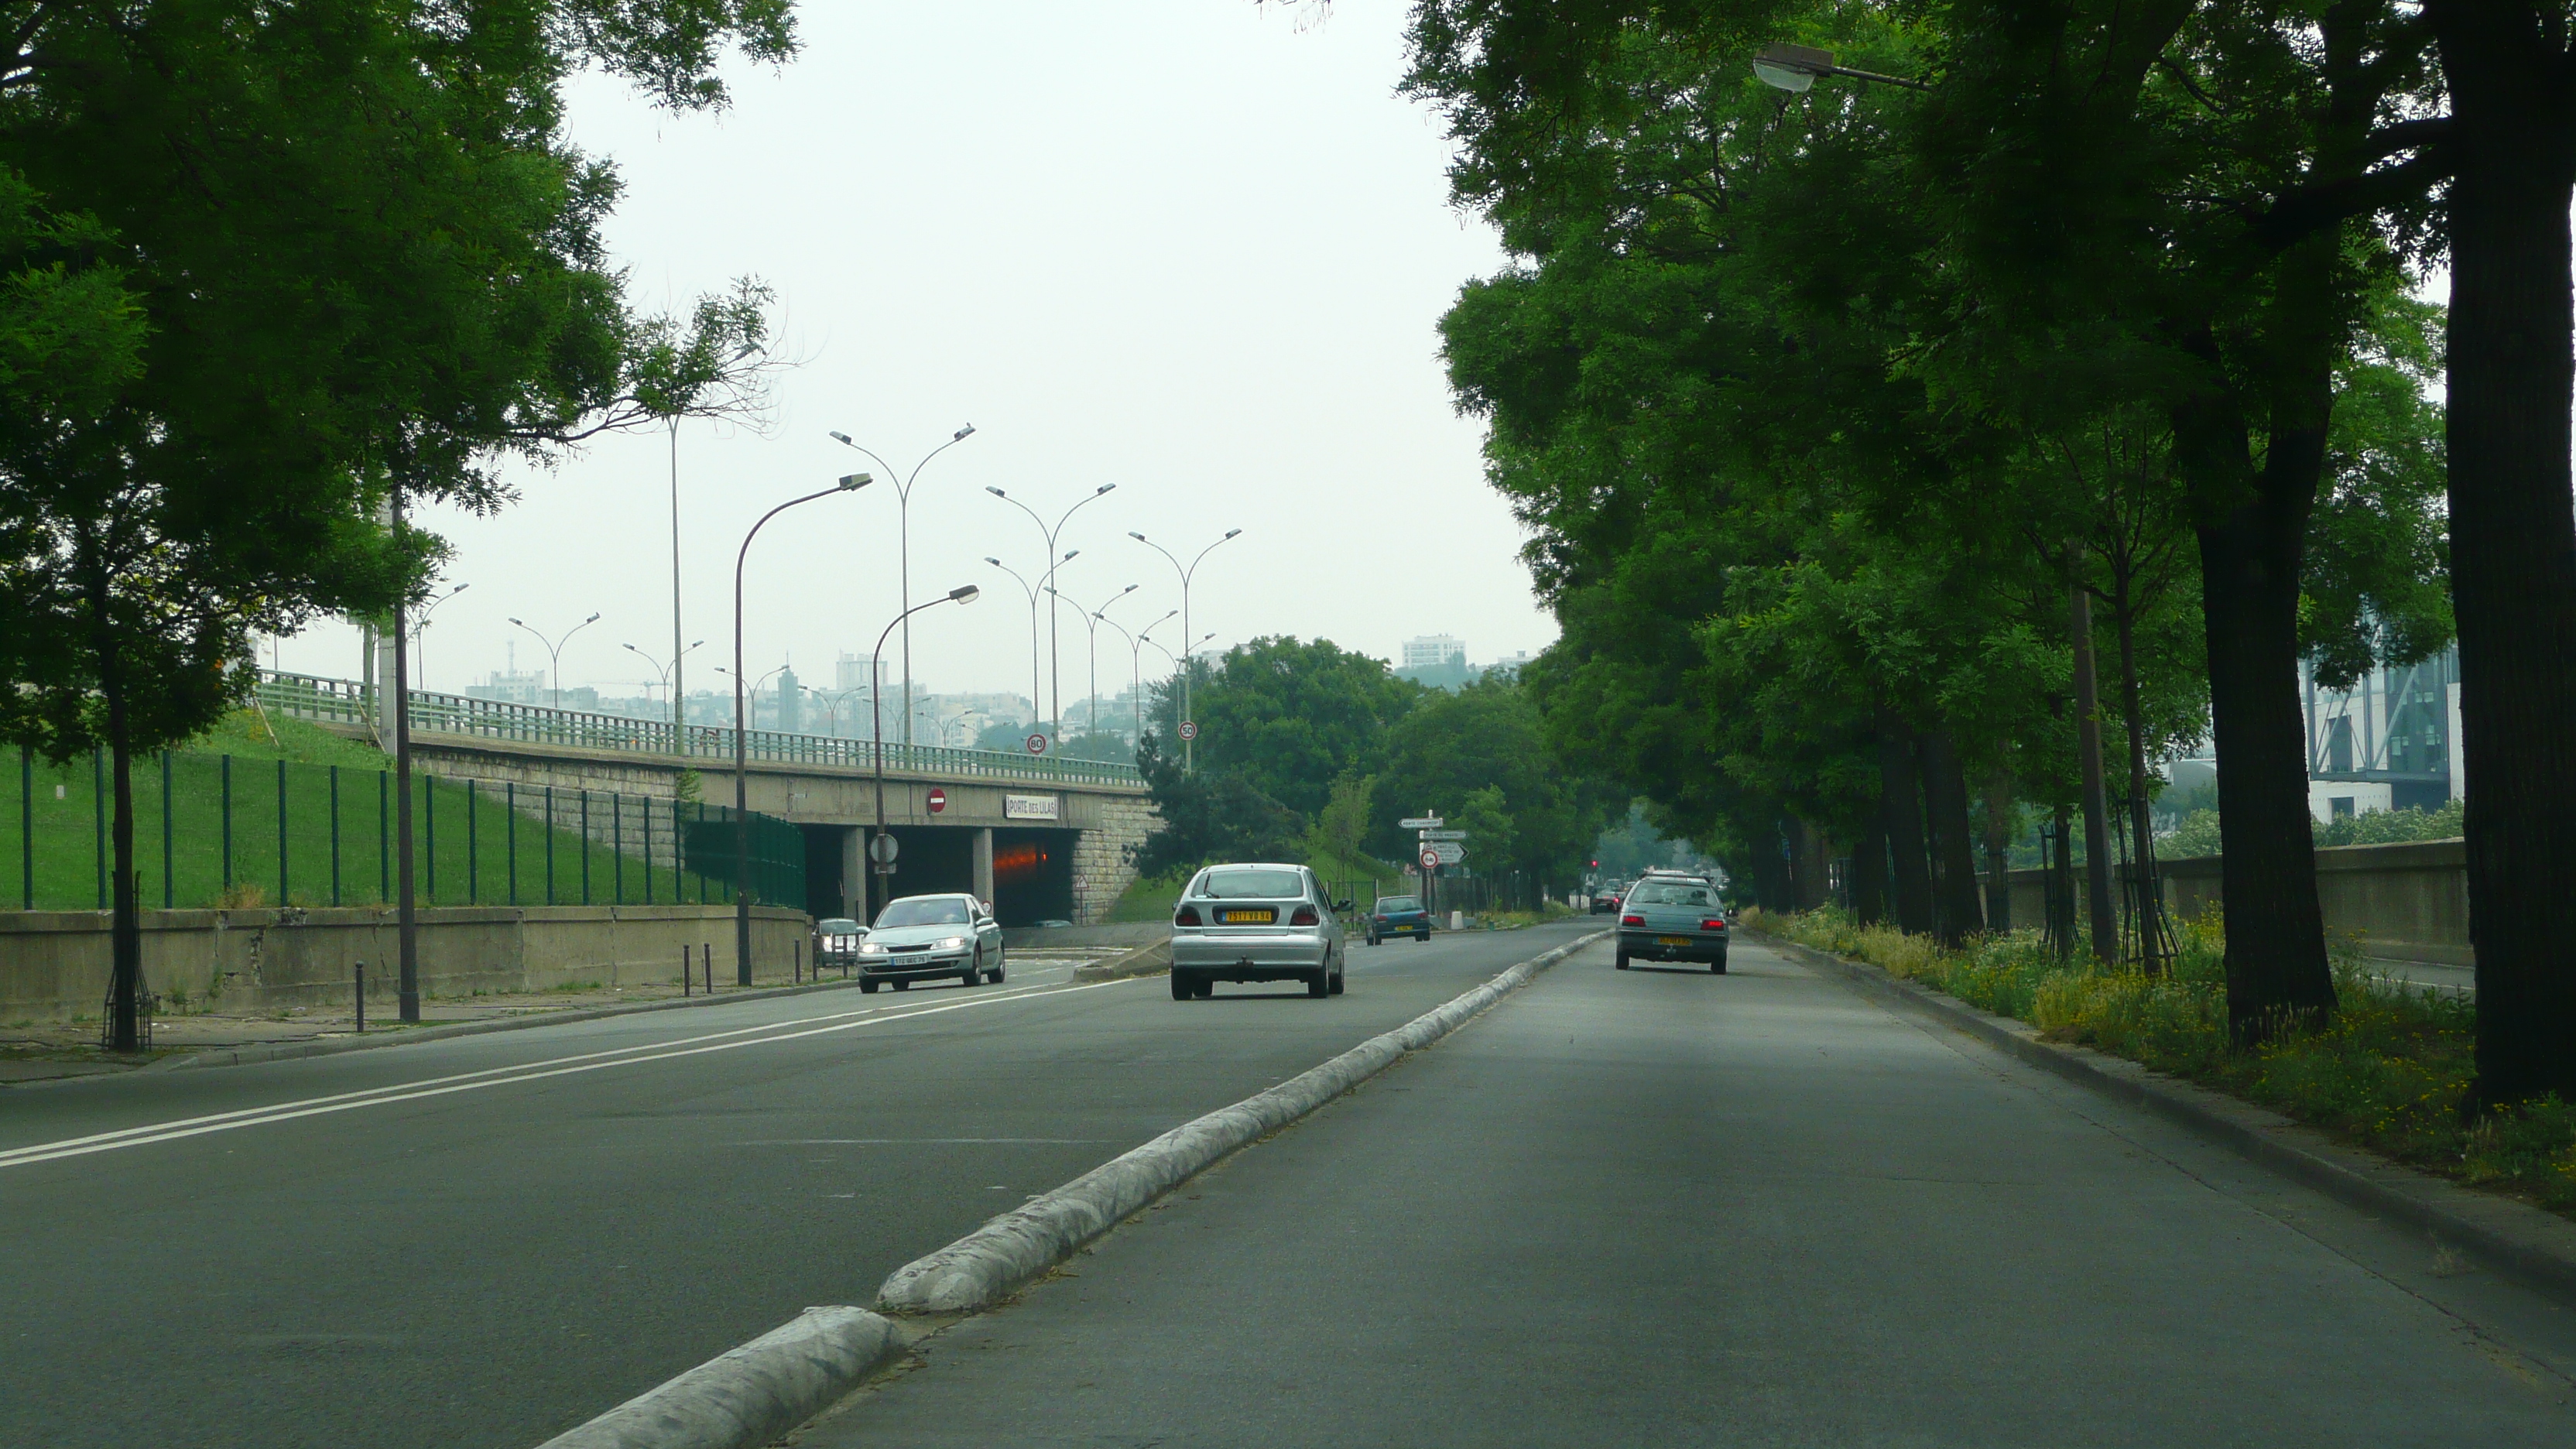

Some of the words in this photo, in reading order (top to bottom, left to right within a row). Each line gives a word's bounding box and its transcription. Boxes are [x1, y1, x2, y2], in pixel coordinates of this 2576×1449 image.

[1030, 739, 1043, 748] 80
[1009, 799, 1028, 814] PORTE
[1029, 803, 1038, 814] DES
[1040, 800, 1054, 815] LILAS
